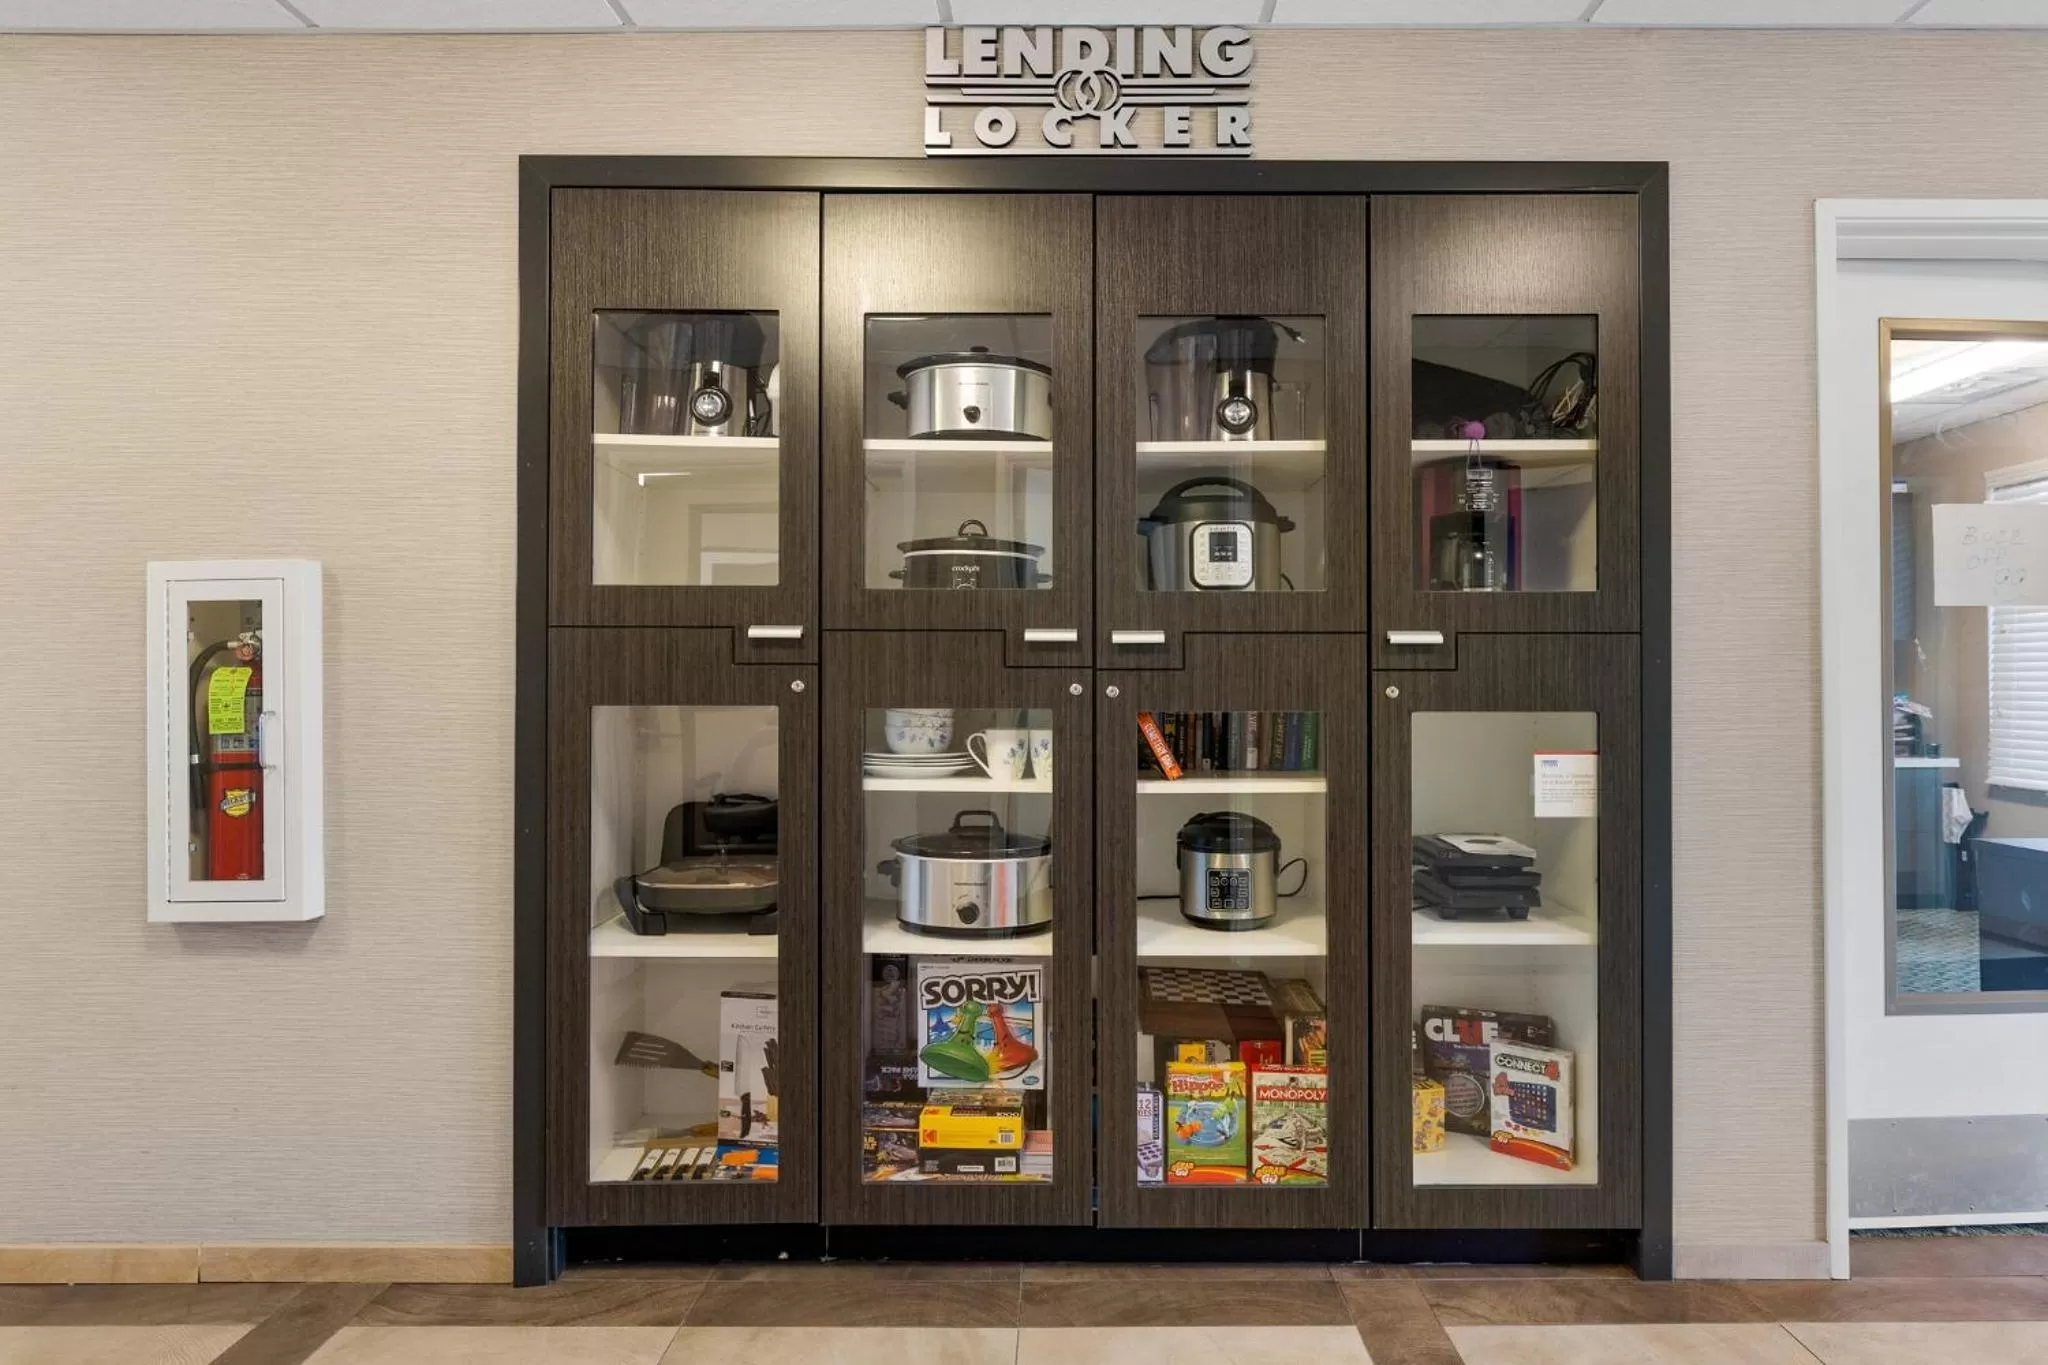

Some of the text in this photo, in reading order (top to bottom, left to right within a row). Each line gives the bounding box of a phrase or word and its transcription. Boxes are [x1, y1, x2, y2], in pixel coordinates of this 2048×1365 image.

[925, 25, 1254, 78] LENDING
[924, 106, 1252, 148] LOCKER
[923, 975, 1037, 1005] SORRY!
[1424, 1017, 1499, 1045] CLUE
[1495, 1054, 1547, 1074] CONNECT
[1259, 1088, 1327, 1101] MONOPOLY
